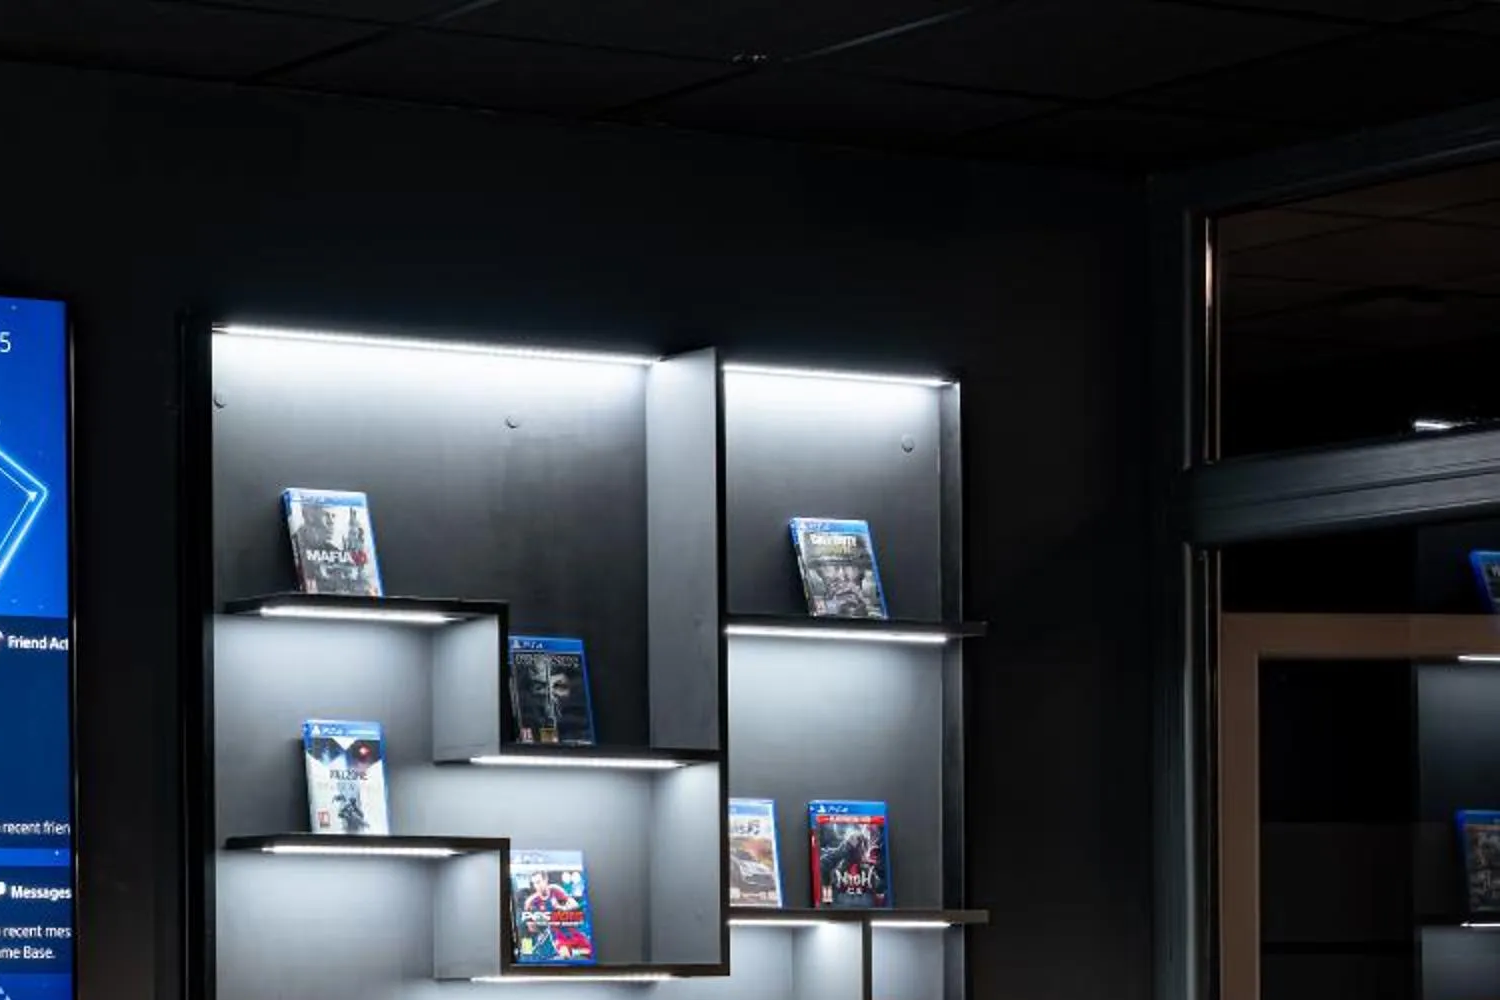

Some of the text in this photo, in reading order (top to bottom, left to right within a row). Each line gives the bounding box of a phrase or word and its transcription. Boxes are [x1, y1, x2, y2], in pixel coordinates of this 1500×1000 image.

[306, 549, 353, 563] MAFIA
[8, 636, 47, 649] Friend
[2, 823, 40, 834] recent
[11, 886, 71, 901] Messages
[3, 926, 42, 937] recent
[17, 946, 54, 959] Base.
